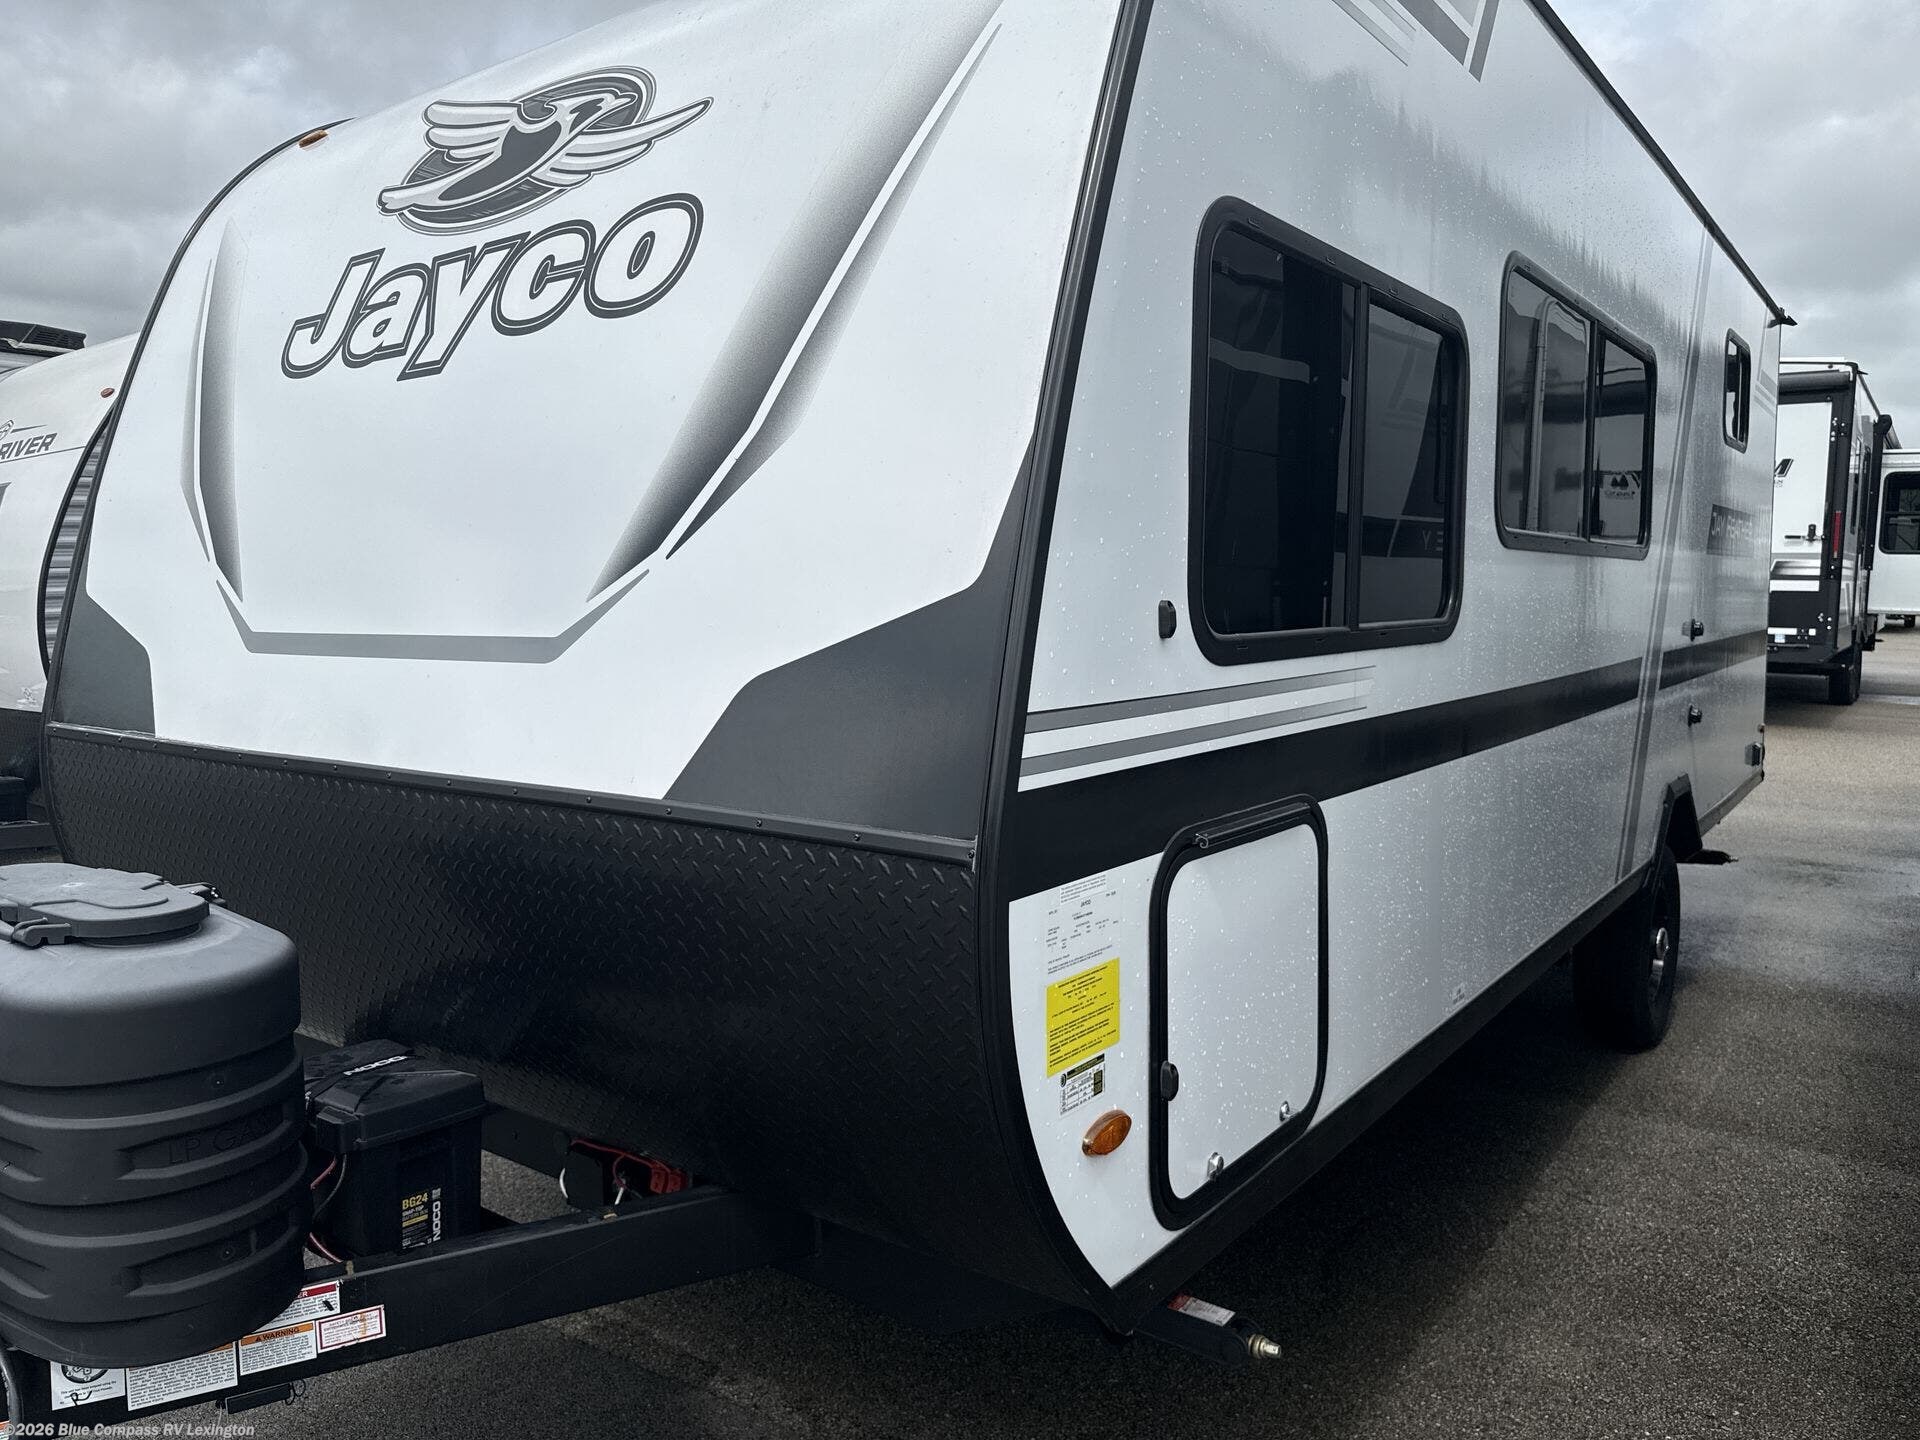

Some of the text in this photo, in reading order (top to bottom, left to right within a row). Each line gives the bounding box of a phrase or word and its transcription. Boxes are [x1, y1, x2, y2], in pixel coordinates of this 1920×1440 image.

[0, 432, 57, 460] RIVER
[402, 1192, 428, 1210] BG24
[432, 1200, 441, 1242] NOCO
[262, 1327, 300, 1340] WARNING
